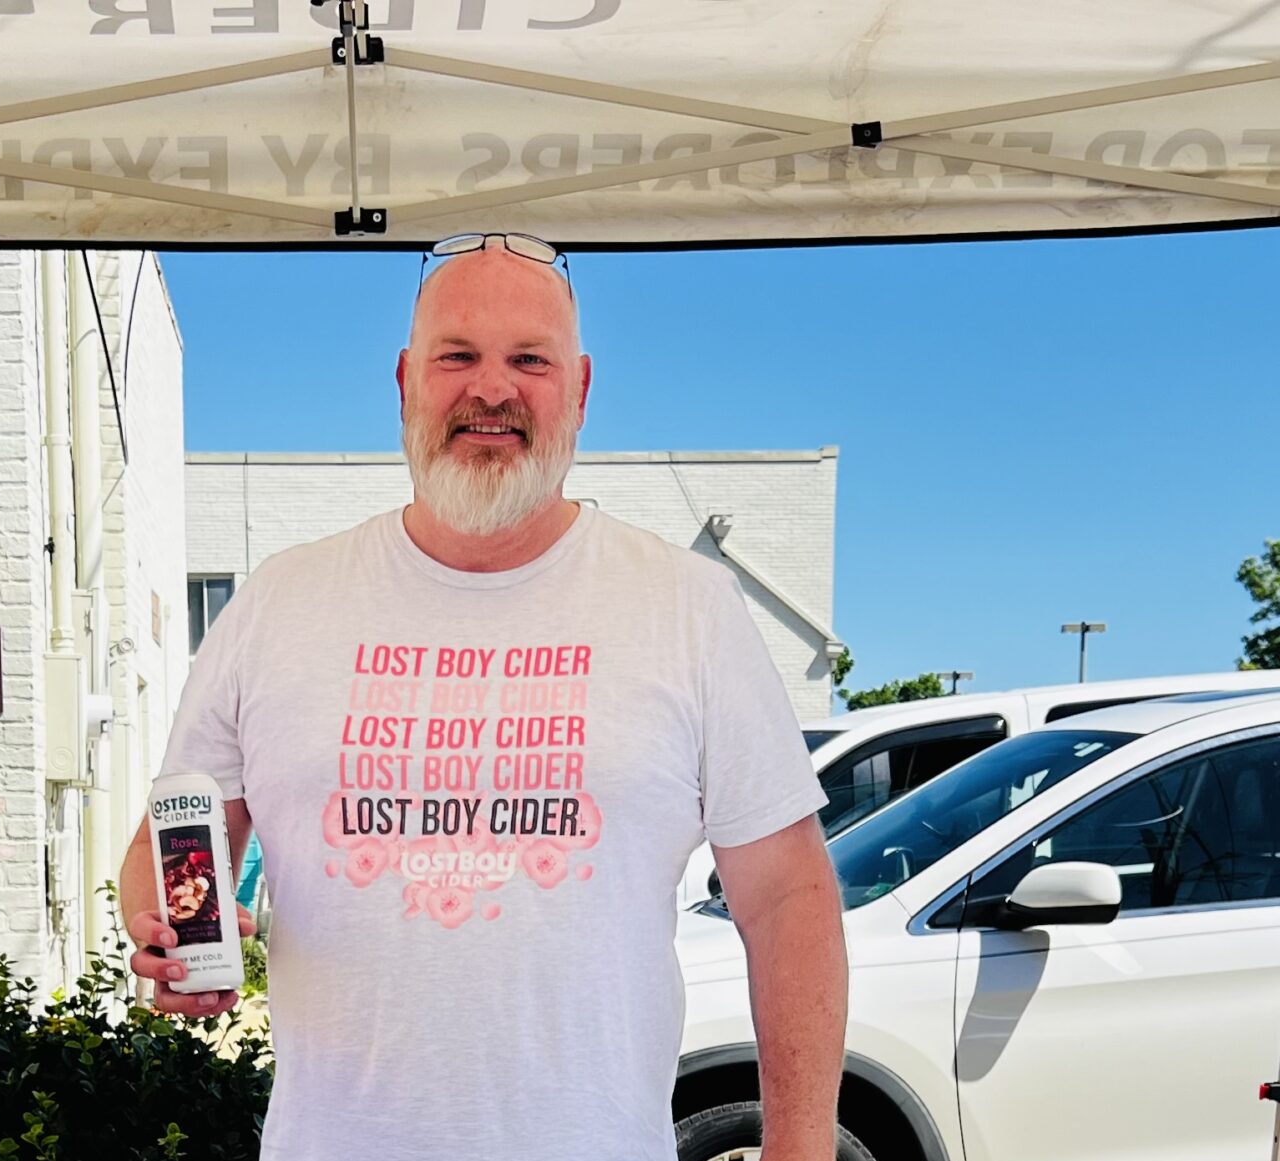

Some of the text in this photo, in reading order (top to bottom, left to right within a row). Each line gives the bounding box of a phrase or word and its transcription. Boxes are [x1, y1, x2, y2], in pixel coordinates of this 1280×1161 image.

[355, 644, 592, 678] LOST BOY CIDER
[349, 679, 588, 713] LOST BOY CIDER
[342, 715, 585, 750] LOST BOY CIDER
[339, 752, 584, 792] LOST BOY CIDER
[164, 811, 197, 823] CIDER
[341, 797, 586, 837] LOST BOY CIDER.
[170, 838, 199, 849] Rose
[429, 874, 485, 888] CIDER
[202, 953, 223, 961] COLD
